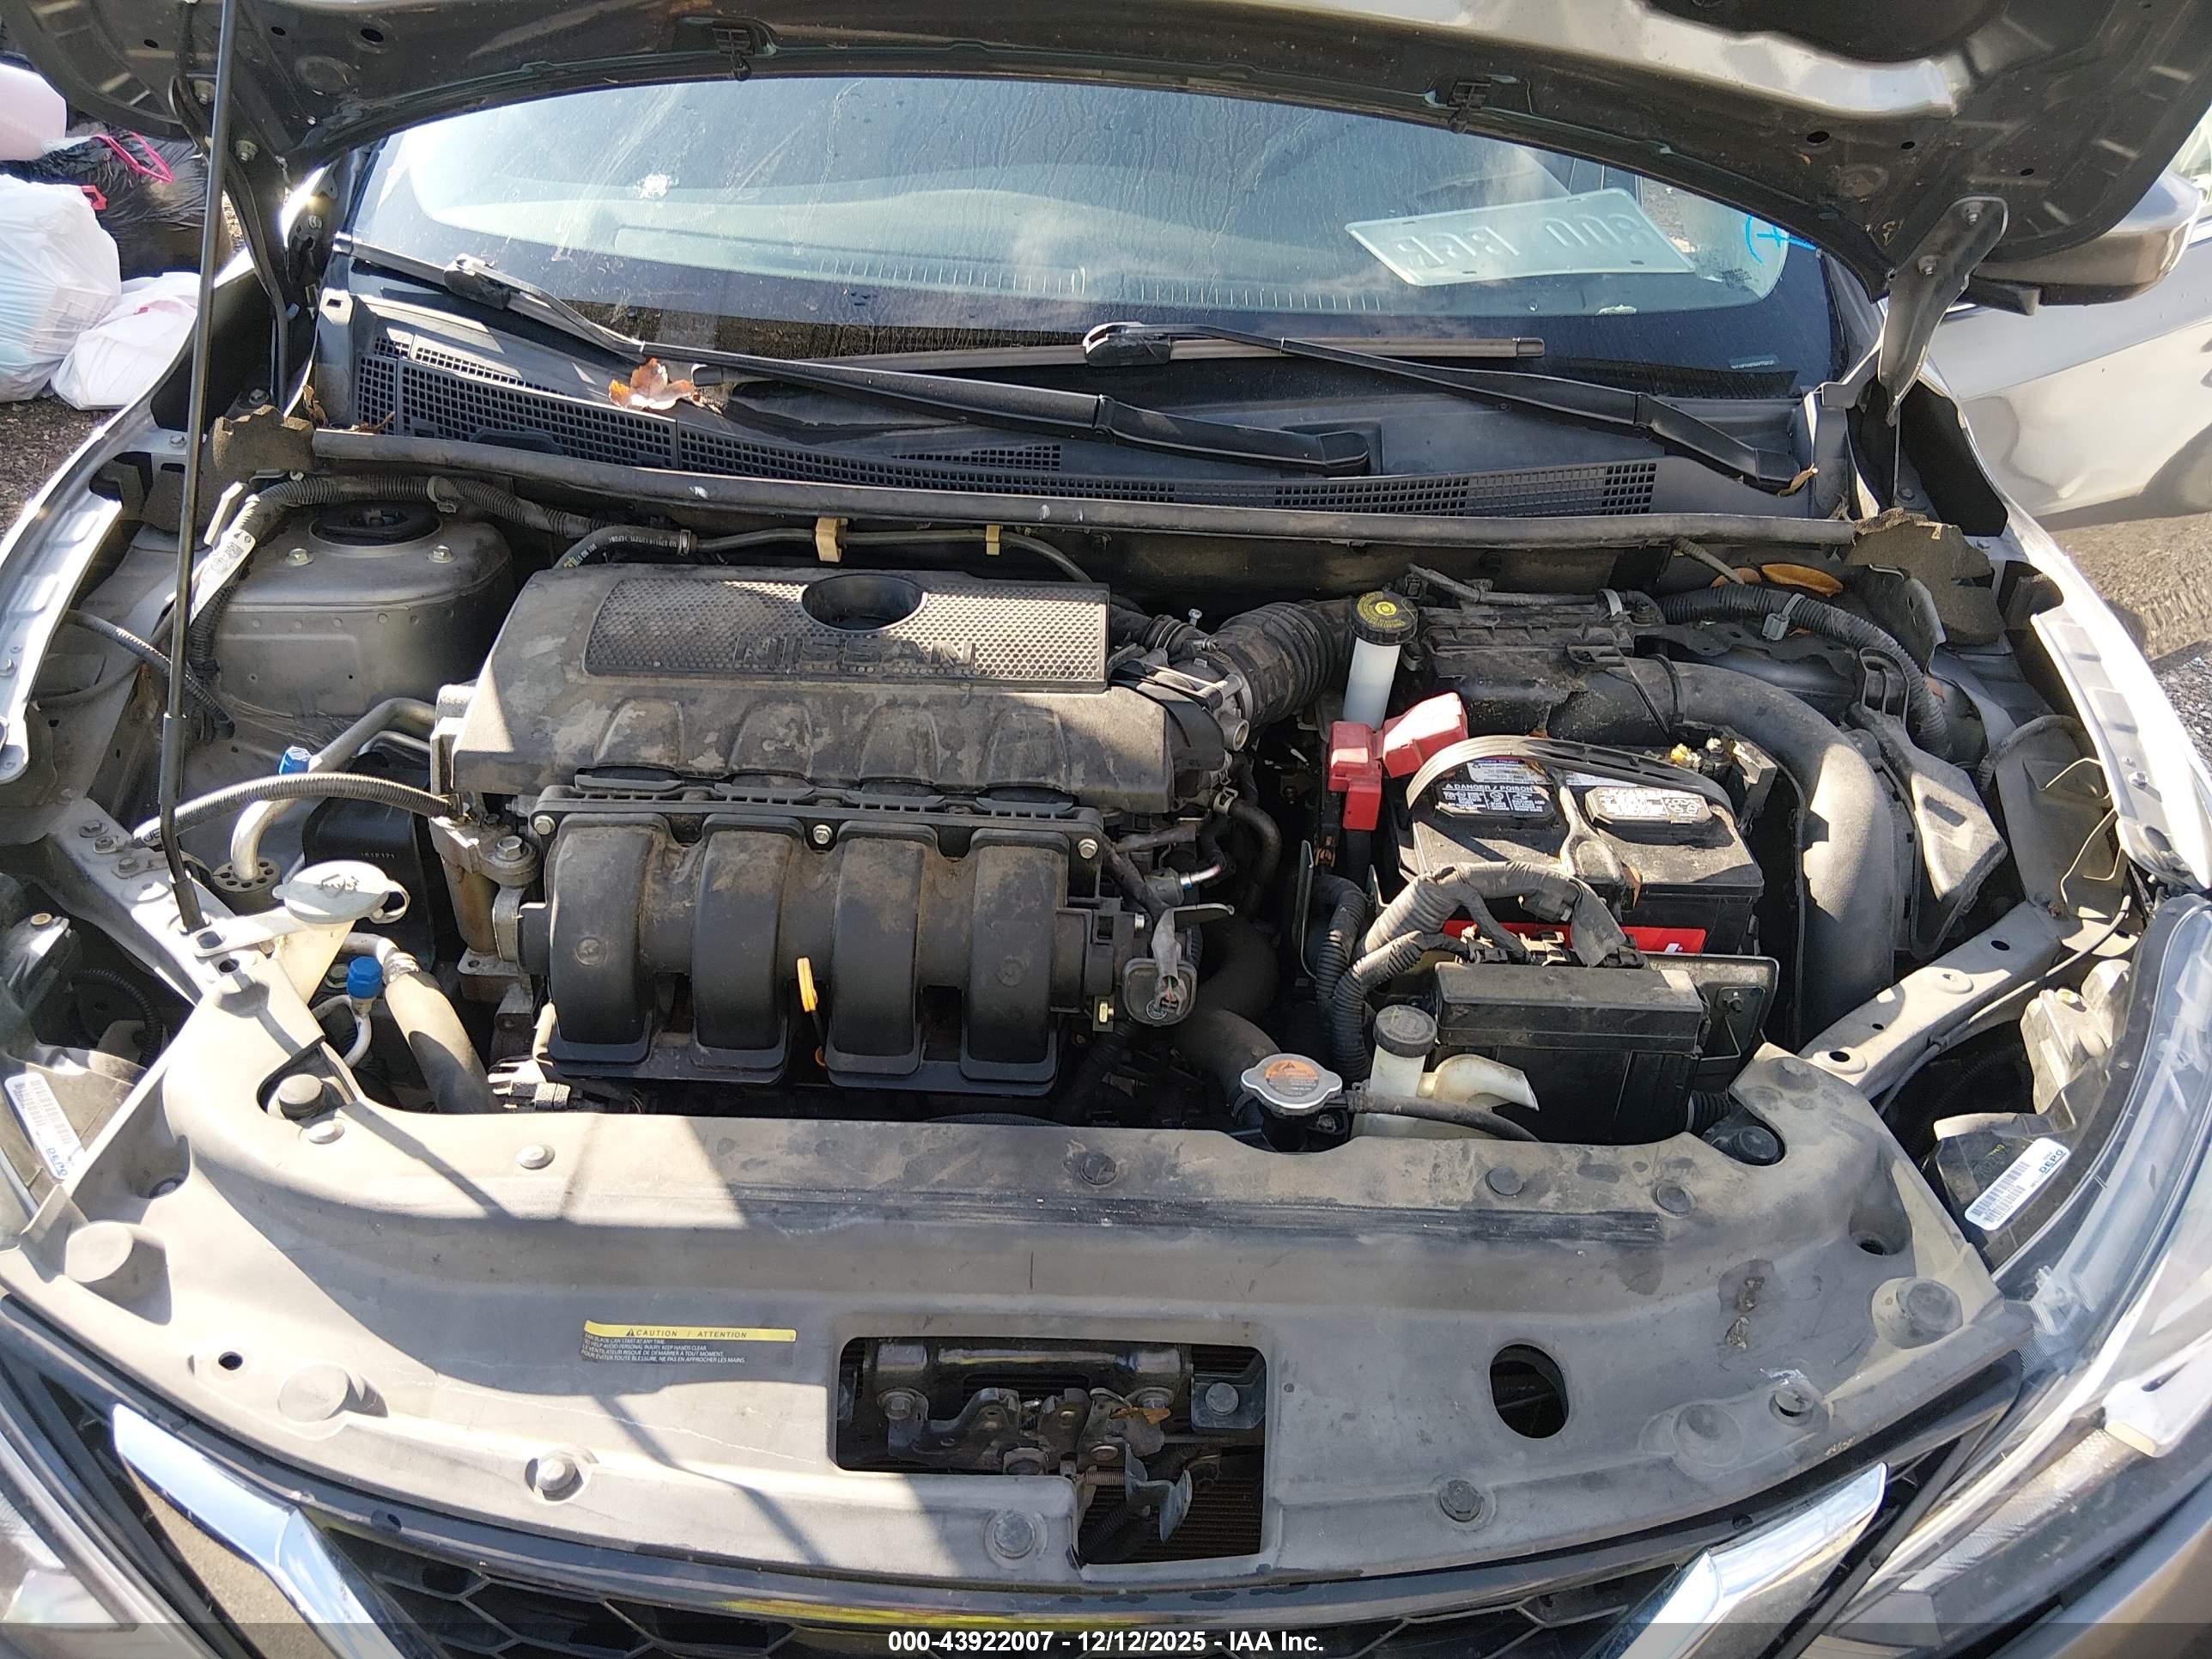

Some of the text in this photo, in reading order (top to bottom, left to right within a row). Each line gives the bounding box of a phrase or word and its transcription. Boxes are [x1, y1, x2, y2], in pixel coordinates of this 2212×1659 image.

[732, 633, 976, 667] NISSAN
[1454, 783, 1491, 792] DANGER
[2039, 1148, 2064, 1173] DEPO
